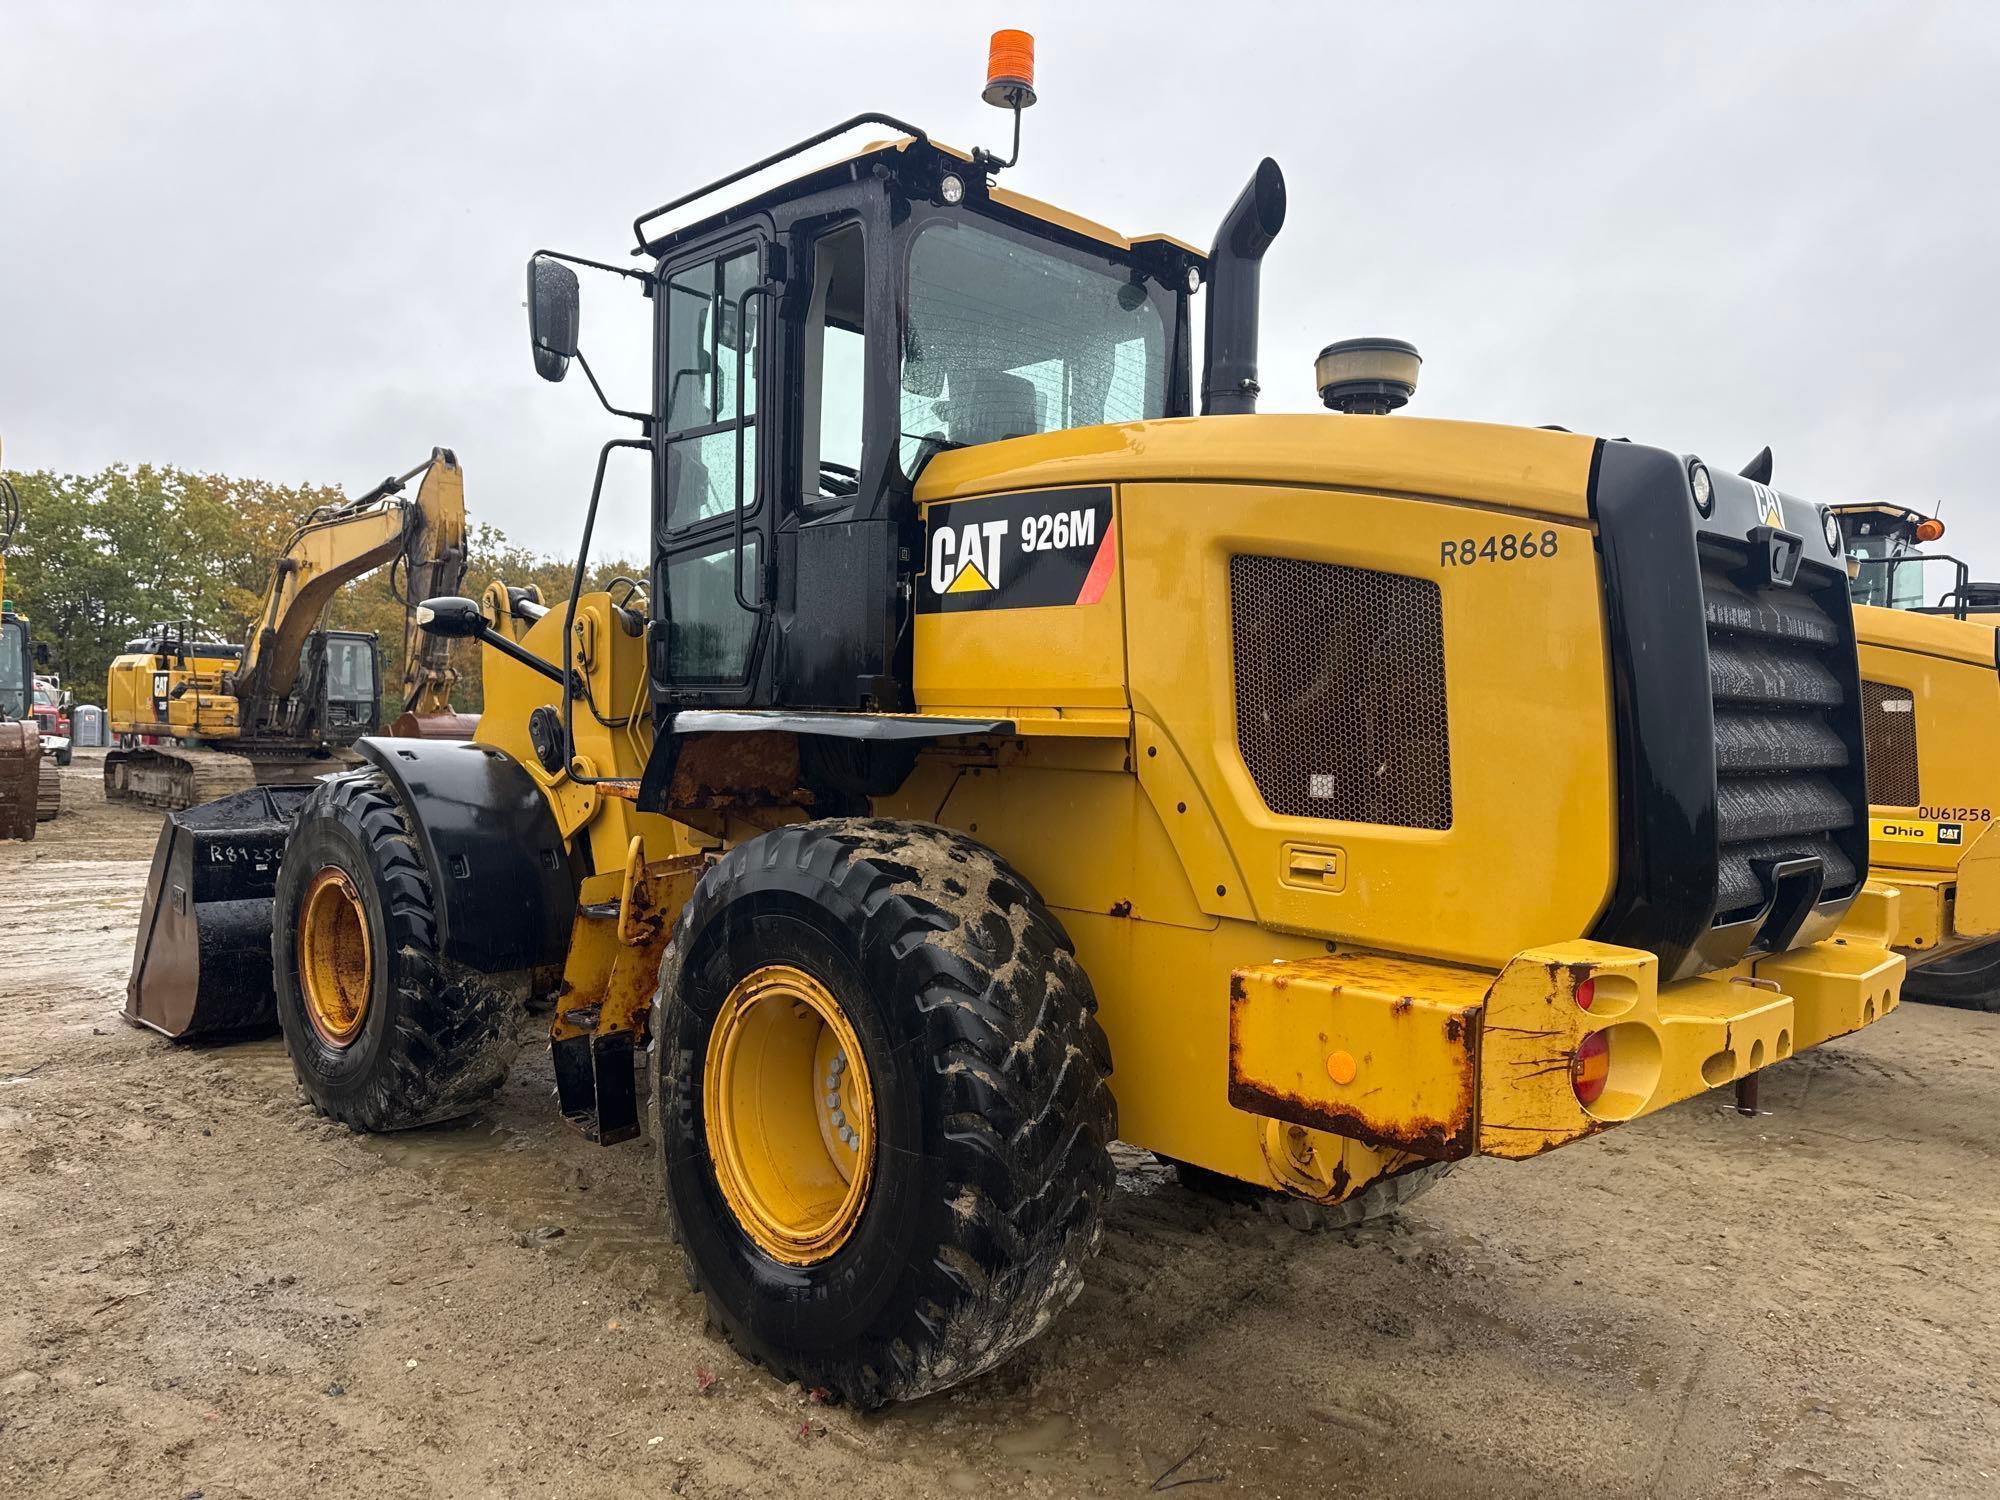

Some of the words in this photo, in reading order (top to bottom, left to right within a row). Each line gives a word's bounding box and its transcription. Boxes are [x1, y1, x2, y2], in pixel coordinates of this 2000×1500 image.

[1751, 482, 1786, 530] CAT
[930, 519, 1009, 594] CAT
[1021, 508, 1096, 552] 926M
[1440, 530, 1558, 567] R84868
[154, 676, 168, 697] CAT
[1918, 806, 1991, 821] DU61258
[1883, 825, 1924, 837] Ohio
[1939, 828, 1960, 840] CAT
